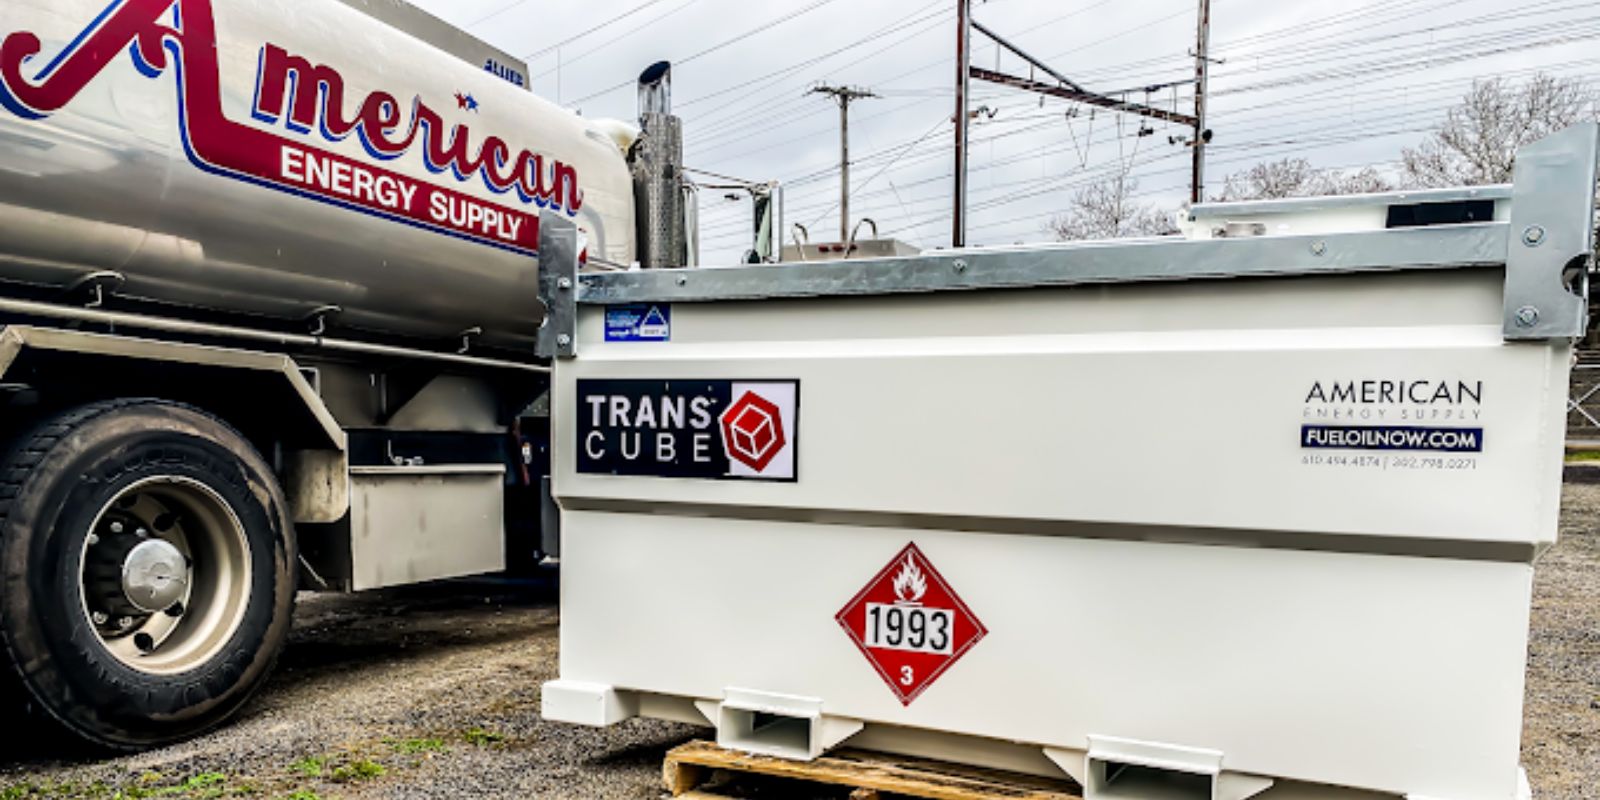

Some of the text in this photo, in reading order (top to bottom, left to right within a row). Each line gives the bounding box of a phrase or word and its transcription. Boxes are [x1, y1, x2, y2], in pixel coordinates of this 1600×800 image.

[0, 0, 584, 217] American
[281, 145, 521, 241] ENERGY SUPPLY
[1305, 380, 1483, 404] AMERICAN
[586, 395, 712, 429] TRANS
[1303, 407, 1481, 420] ENERGY SUPPLY
[585, 431, 711, 462] CUBE
[1307, 429, 1477, 448] FUELOILNOW.COM
[870, 606, 949, 650] 1993
[900, 665, 913, 686] 3
